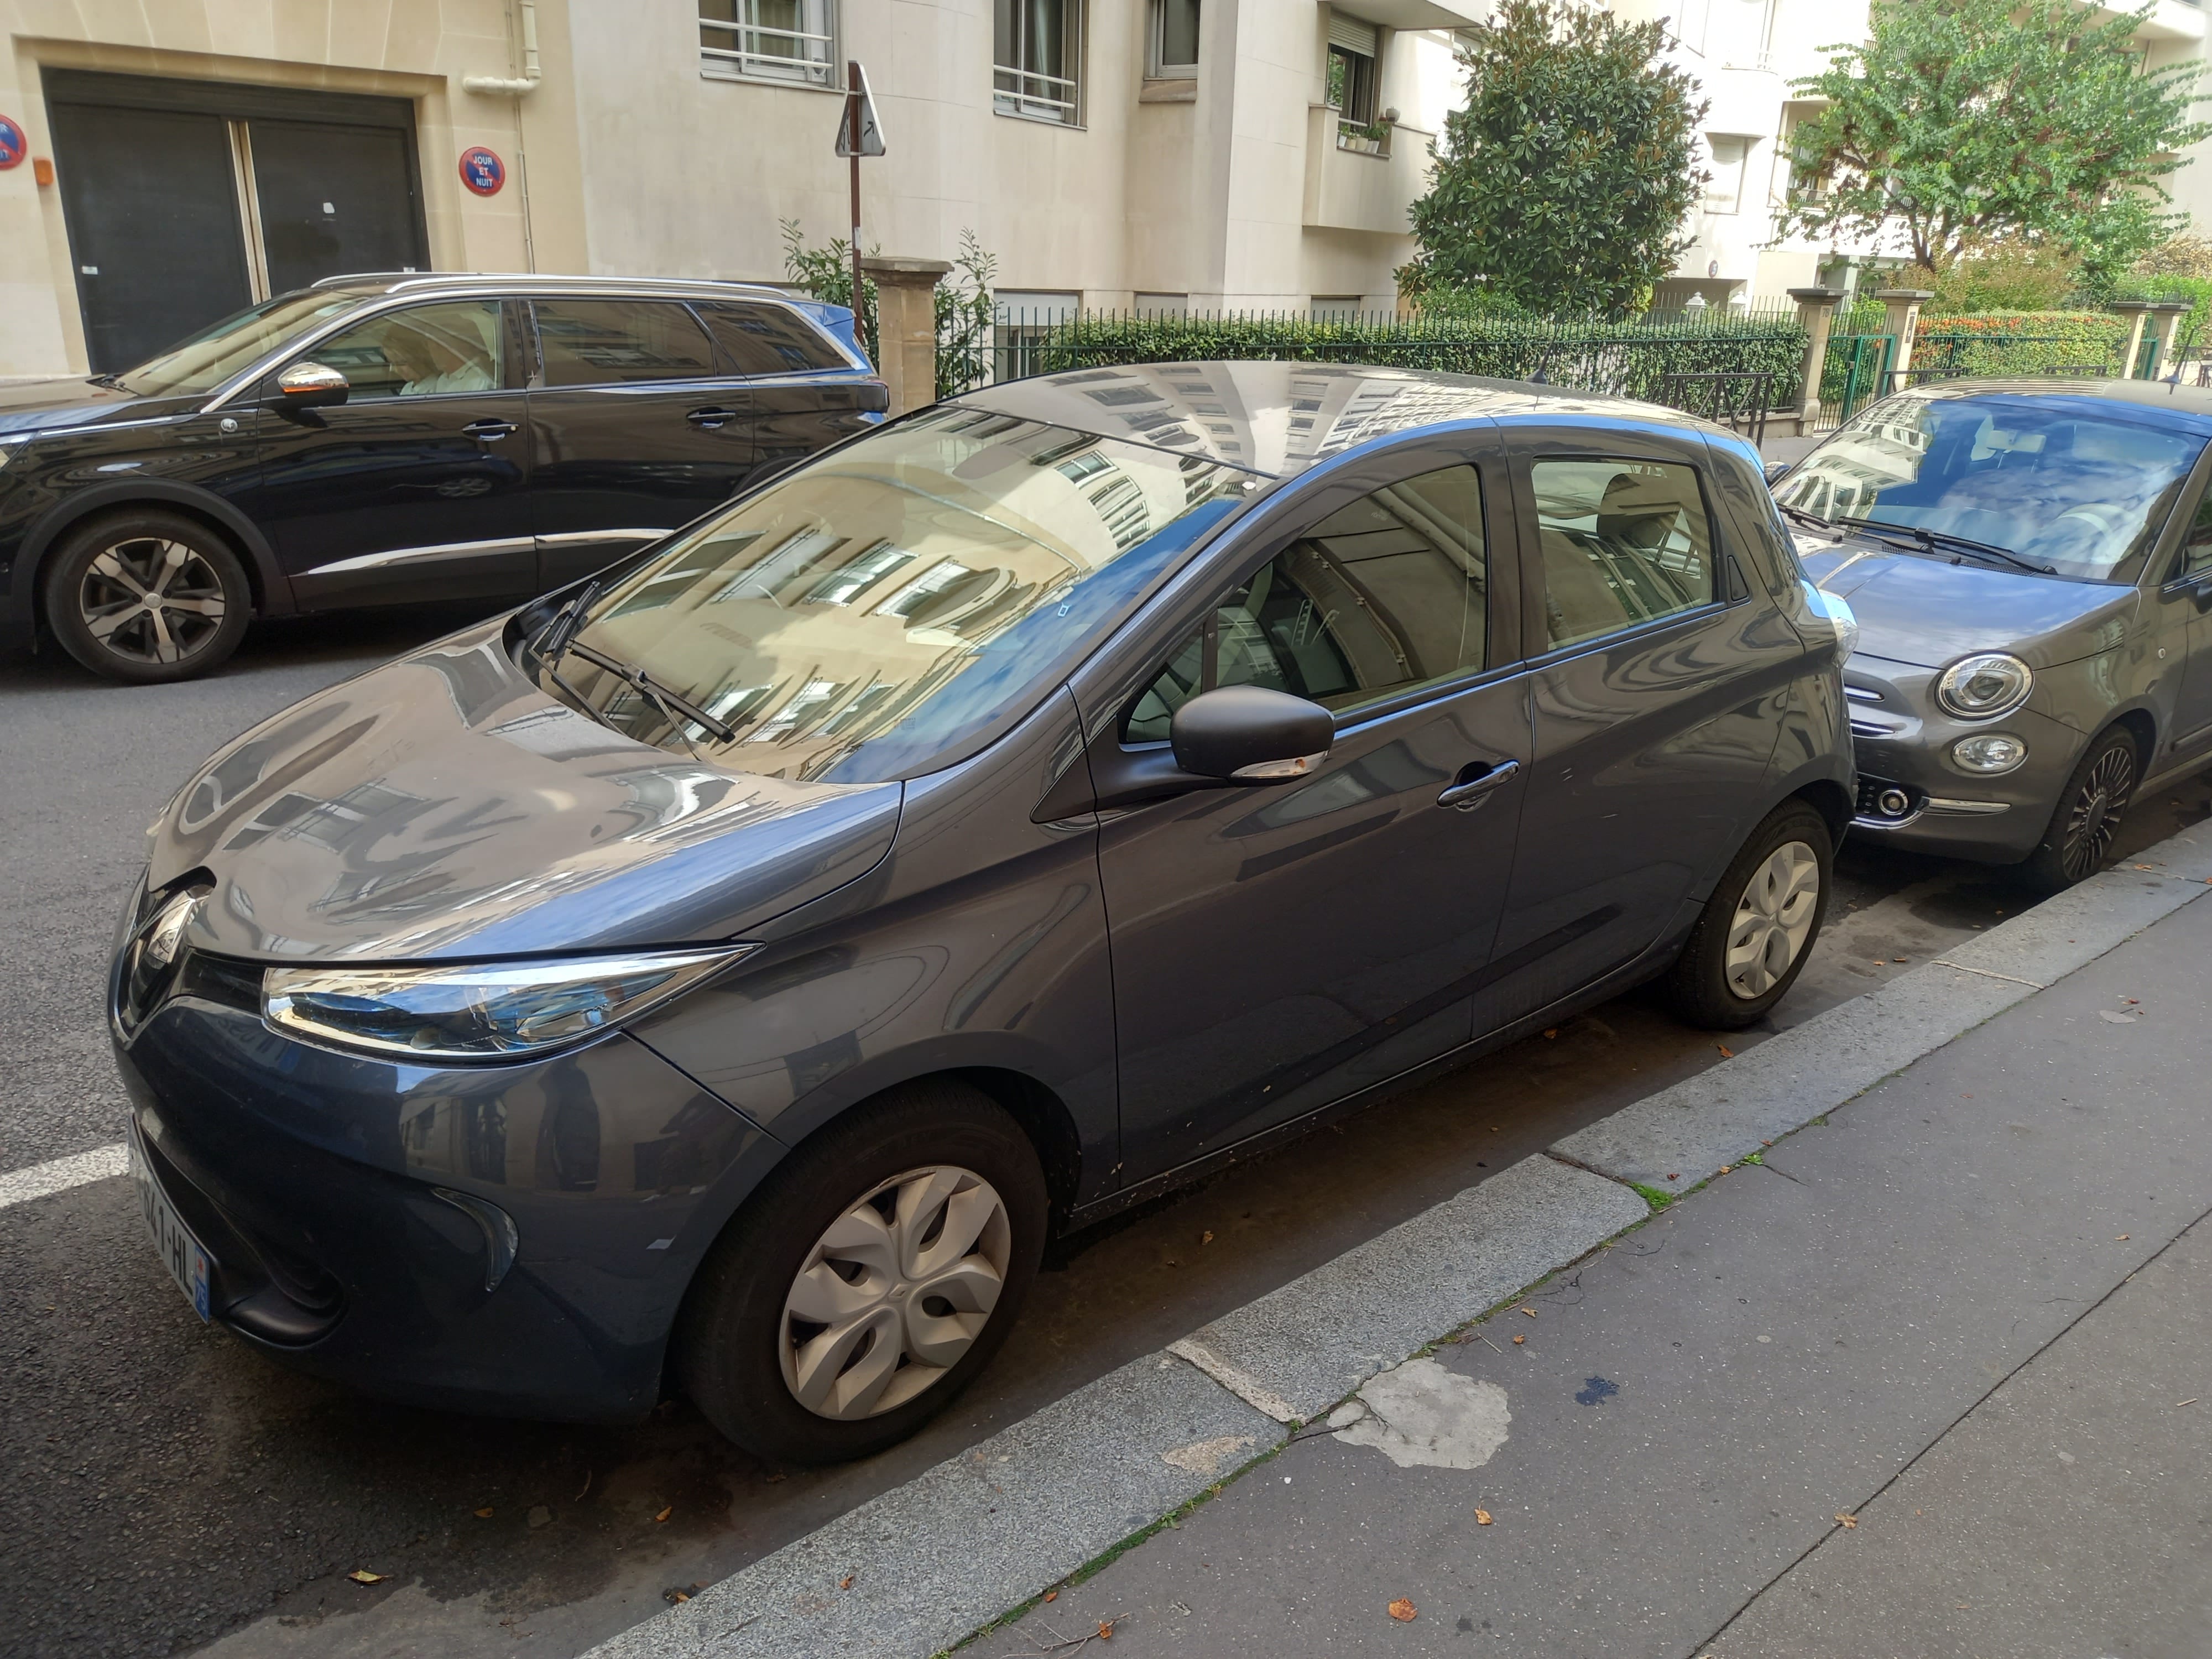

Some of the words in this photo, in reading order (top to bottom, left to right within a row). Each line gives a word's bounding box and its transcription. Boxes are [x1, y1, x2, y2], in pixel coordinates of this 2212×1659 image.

[473, 155, 493, 165] JOUR
[479, 167, 488, 176] ET
[476, 178, 493, 187] NUIT
[196, 1285, 206, 1310] 75
